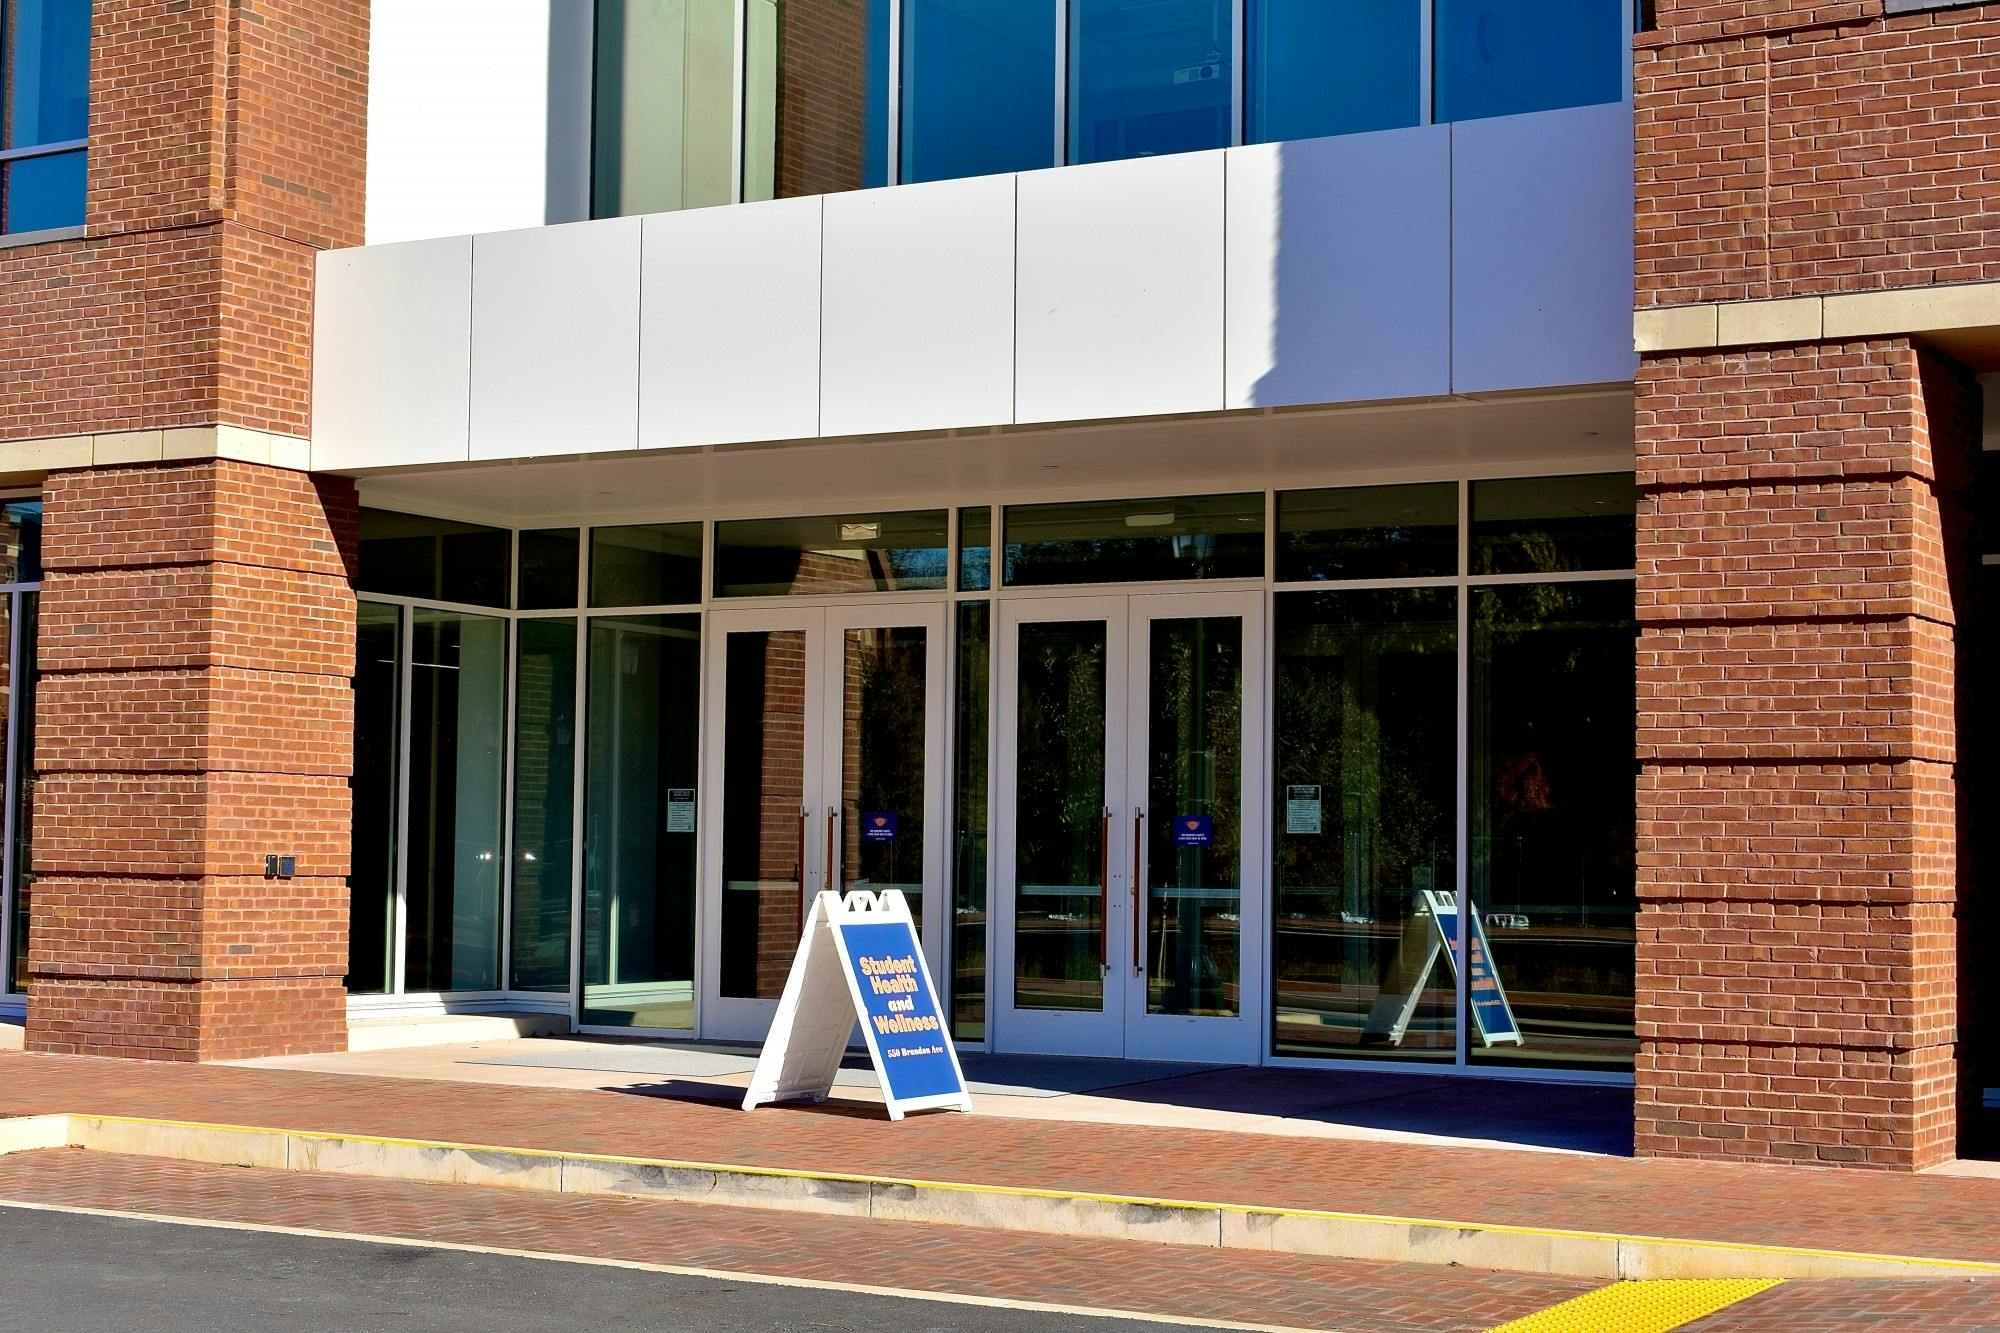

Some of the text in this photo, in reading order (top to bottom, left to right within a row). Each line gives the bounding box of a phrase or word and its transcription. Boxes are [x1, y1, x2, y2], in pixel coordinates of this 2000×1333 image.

[859, 955, 917, 975] Student
[870, 974, 918, 994] Health
[888, 994, 914, 1011] and
[873, 1014, 939, 1034] Wellness
[887, 1045, 944, 1058] 550 Brandon Ave
